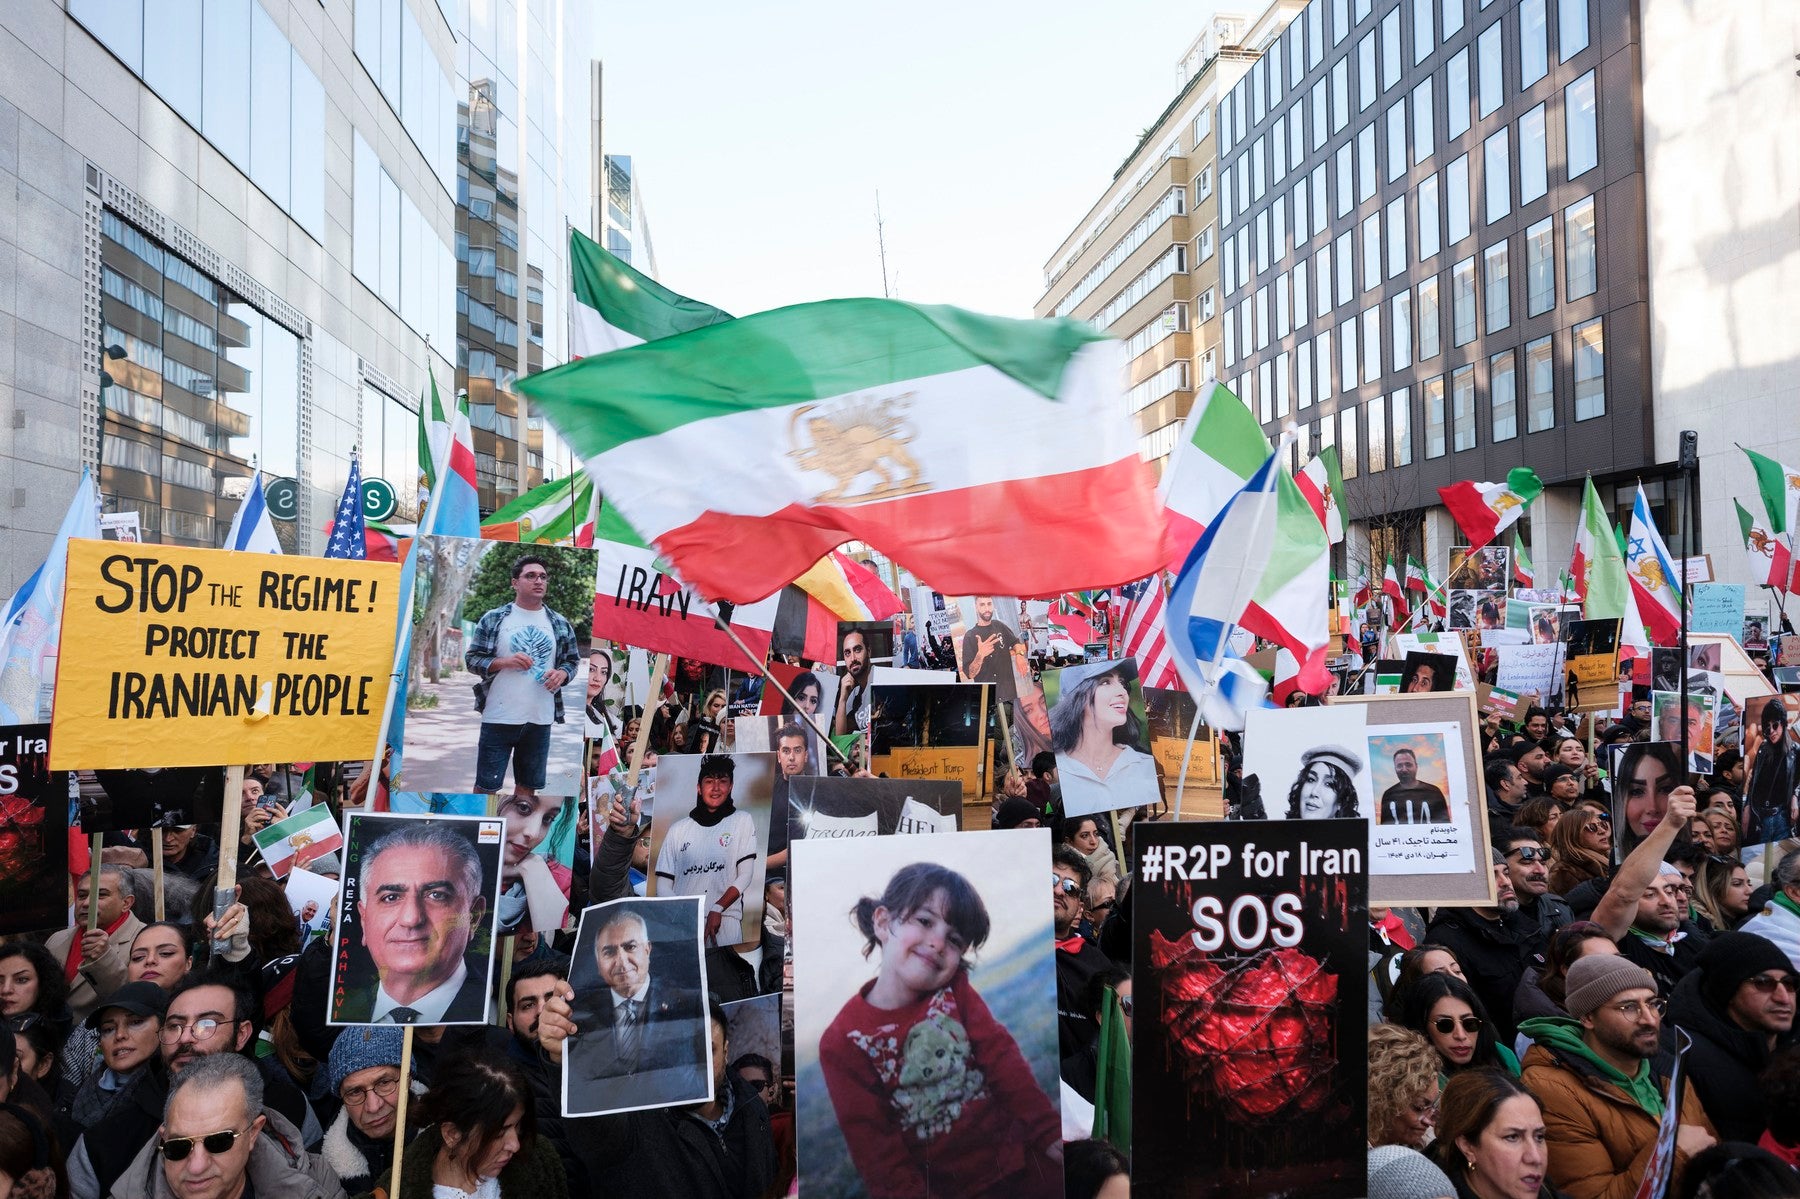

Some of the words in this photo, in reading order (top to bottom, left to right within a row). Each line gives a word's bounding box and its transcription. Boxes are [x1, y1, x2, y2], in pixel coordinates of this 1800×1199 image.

[366, 489, 380, 509] S
[95, 554, 203, 613] STOP
[207, 583, 243, 608] THE
[614, 564, 692, 621] IRAN
[145, 623, 260, 660] PROTECT
[282, 631, 329, 660] THE
[108, 671, 258, 719] IRANIAN
[272, 672, 373, 716] PEOPLE
[17, 735, 47, 754] Ira
[901, 762, 938, 776] President
[941, 757, 965, 775] Trump
[350, 816, 362, 863] KING
[1142, 844, 1231, 882] #R2P
[1242, 842, 1290, 878] for
[1300, 841, 1361, 876] Iran
[343, 877, 356, 923] REZA
[1192, 893, 1304, 952] SOS
[333, 938, 349, 1019] PAHLAVI
